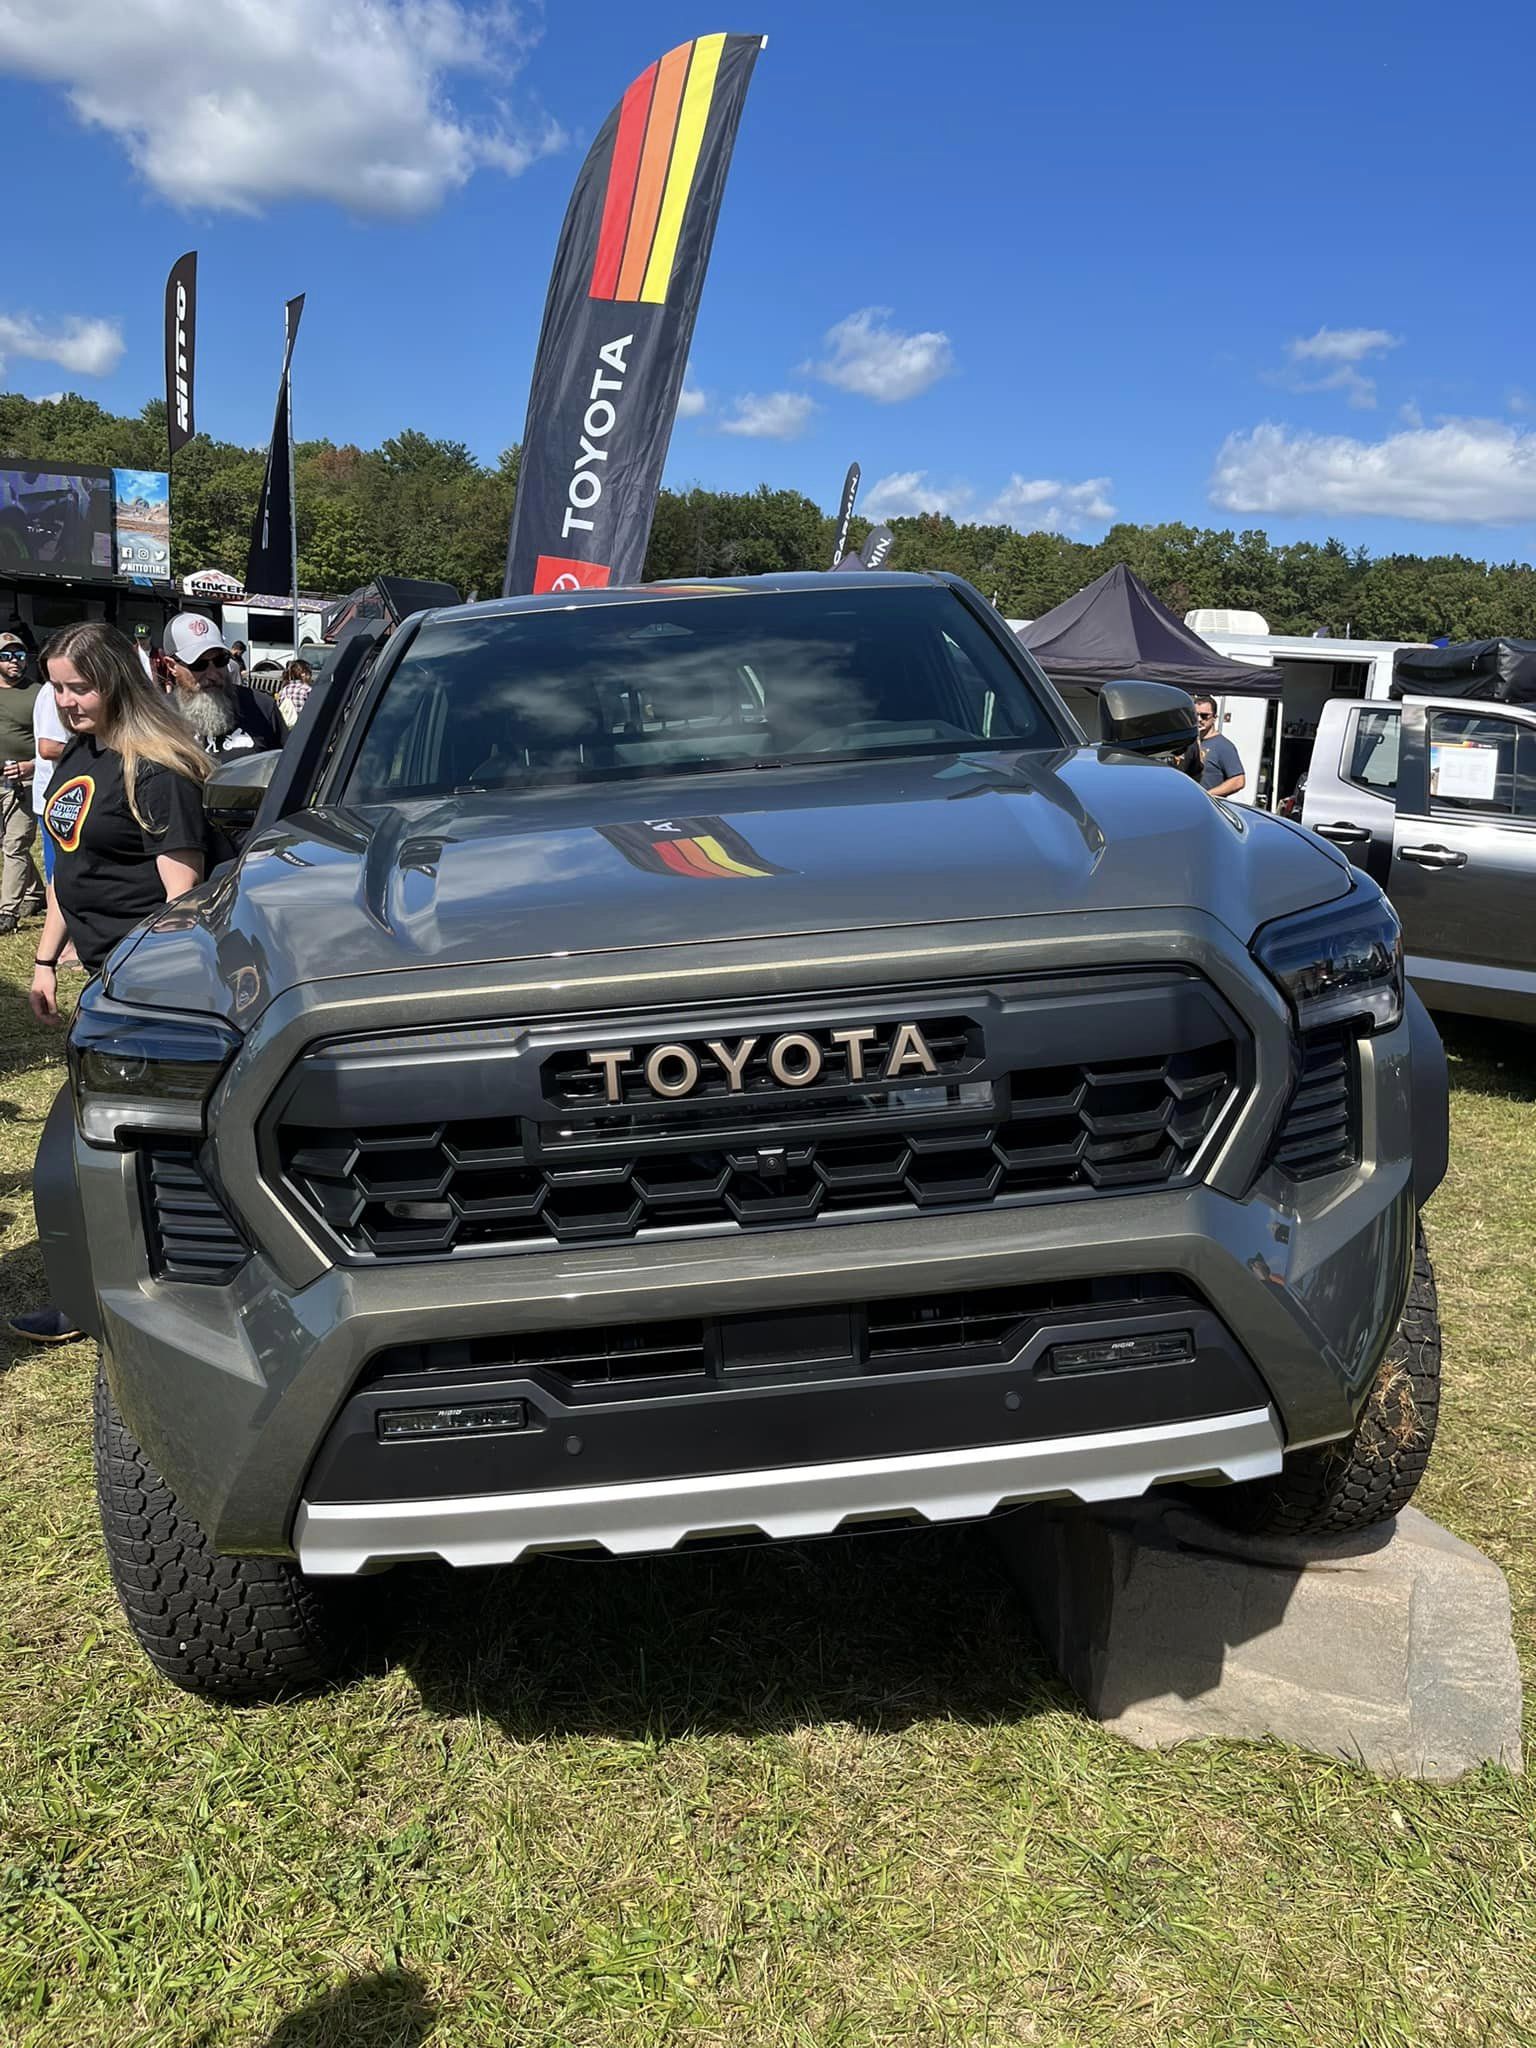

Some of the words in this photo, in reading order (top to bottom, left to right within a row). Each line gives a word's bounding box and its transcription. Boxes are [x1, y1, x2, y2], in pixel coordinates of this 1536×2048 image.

[561, 334, 634, 539] TOYOTA
[120, 562, 167, 575] #NITTOTIRE
[587, 1022, 938, 1105] TOYOTA
